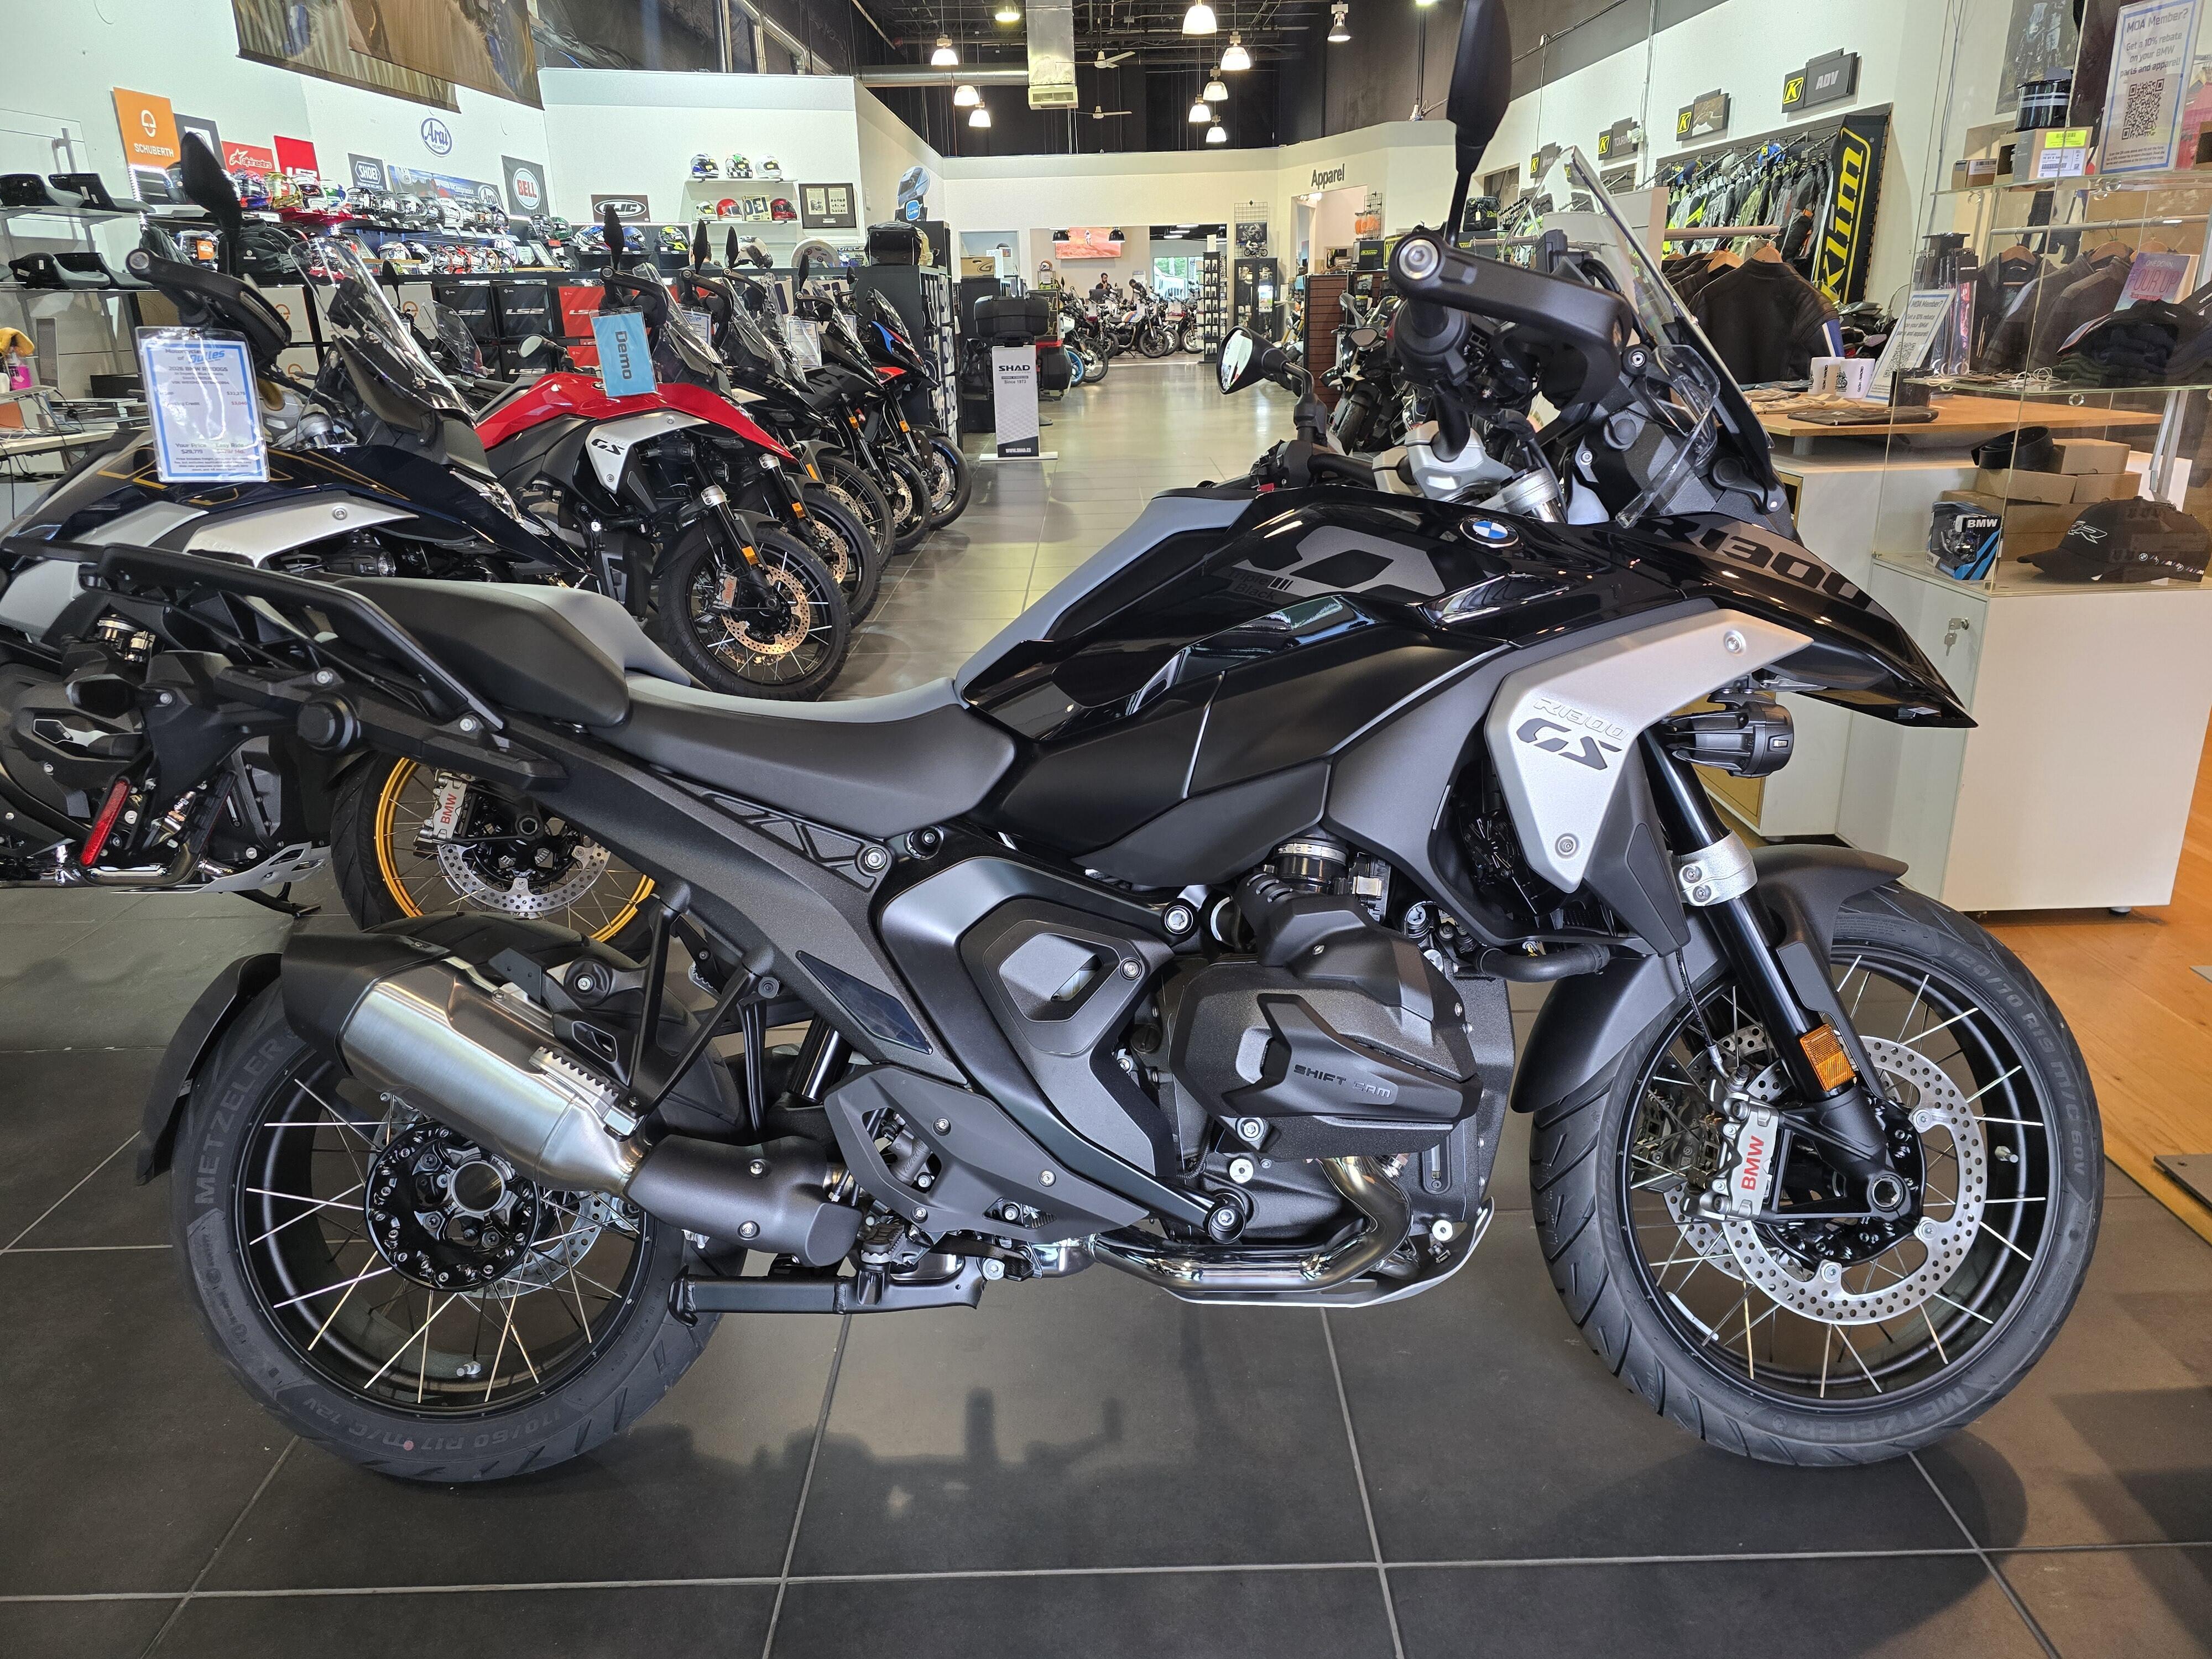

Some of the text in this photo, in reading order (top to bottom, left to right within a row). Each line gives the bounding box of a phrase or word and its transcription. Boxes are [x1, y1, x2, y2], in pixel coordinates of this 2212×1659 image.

[2126, 8, 2188, 33] MOA Member?
[2126, 42, 2137, 51] Get
[2145, 36, 2157, 47] 10%
[2159, 32, 2182, 44] rebate
[2139, 51, 2155, 62] your
[2156, 45, 2176, 57] BMW
[2120, 57, 2182, 79] parts and apparel!
[1785, 80, 1802, 101] K
[1815, 70, 1839, 90] ADV
[424, 121, 448, 146] Arai
[1678, 114, 1691, 131] K
[134, 143, 174, 158] SCHUBERTH
[1599, 137, 1609, 153] K
[358, 164, 379, 181] SHOEI
[1311, 163, 1345, 190] Apparel
[517, 179, 538, 199] BELL
[615, 330, 632, 380] Demo
[591, 439, 625, 455] GS
[1967, 519, 1998, 528] BMW
[1648, 518, 1874, 611] R1300
[1229, 569, 1269, 586] Triple
[1233, 583, 1277, 601] Black
[1533, 697, 1629, 742] R1300
[1516, 717, 1623, 771] GS
[440, 792, 457, 825] BMW
[1947, 946, 2086, 1176] 120/70 R19 M/C 60V
[1293, 1064, 1347, 1086] SHIFT
[195, 1037, 278, 1204] METZELER
[1740, 1135, 1765, 1191] BMW
[1794, 1386, 1969, 1439] METZELER
